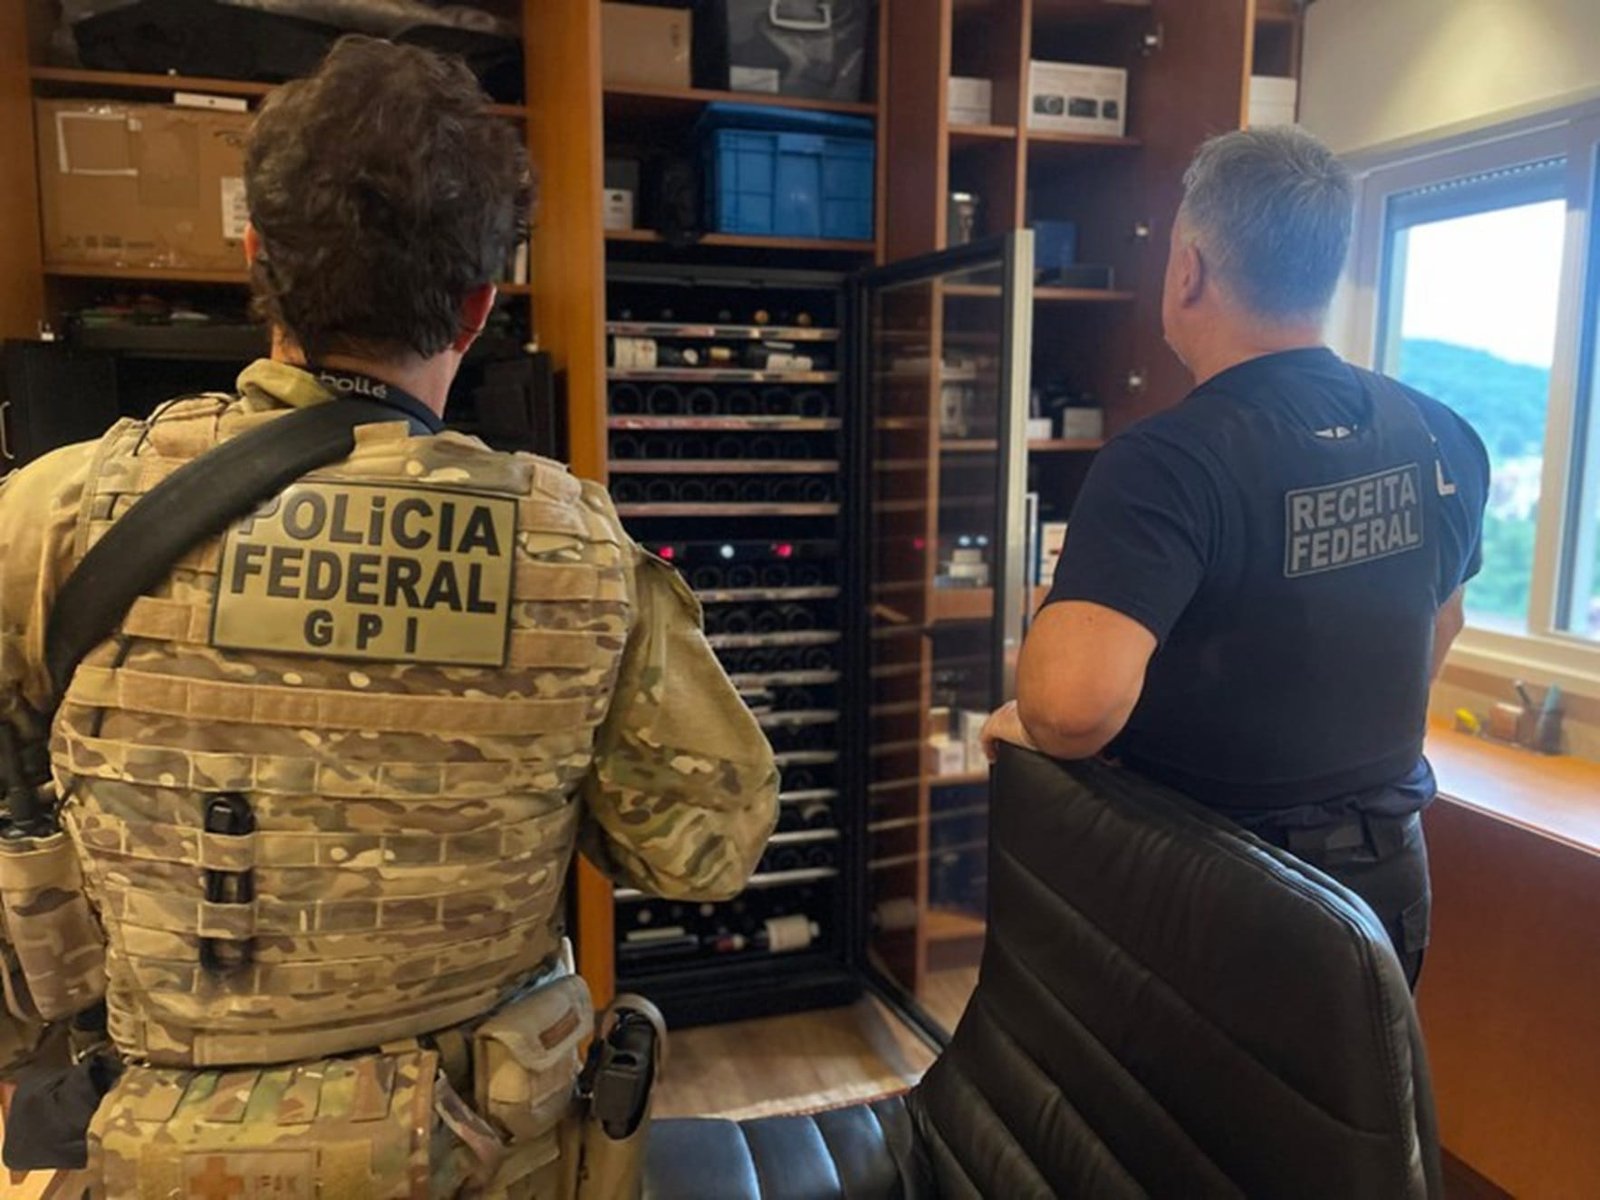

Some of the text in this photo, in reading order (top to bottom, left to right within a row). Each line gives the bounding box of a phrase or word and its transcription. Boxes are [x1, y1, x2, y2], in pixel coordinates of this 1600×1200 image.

[1292, 472, 1417, 531] RECEITA
[1292, 510, 1419, 571] FEDERAL
[230, 543, 497, 614] FEDERAL
